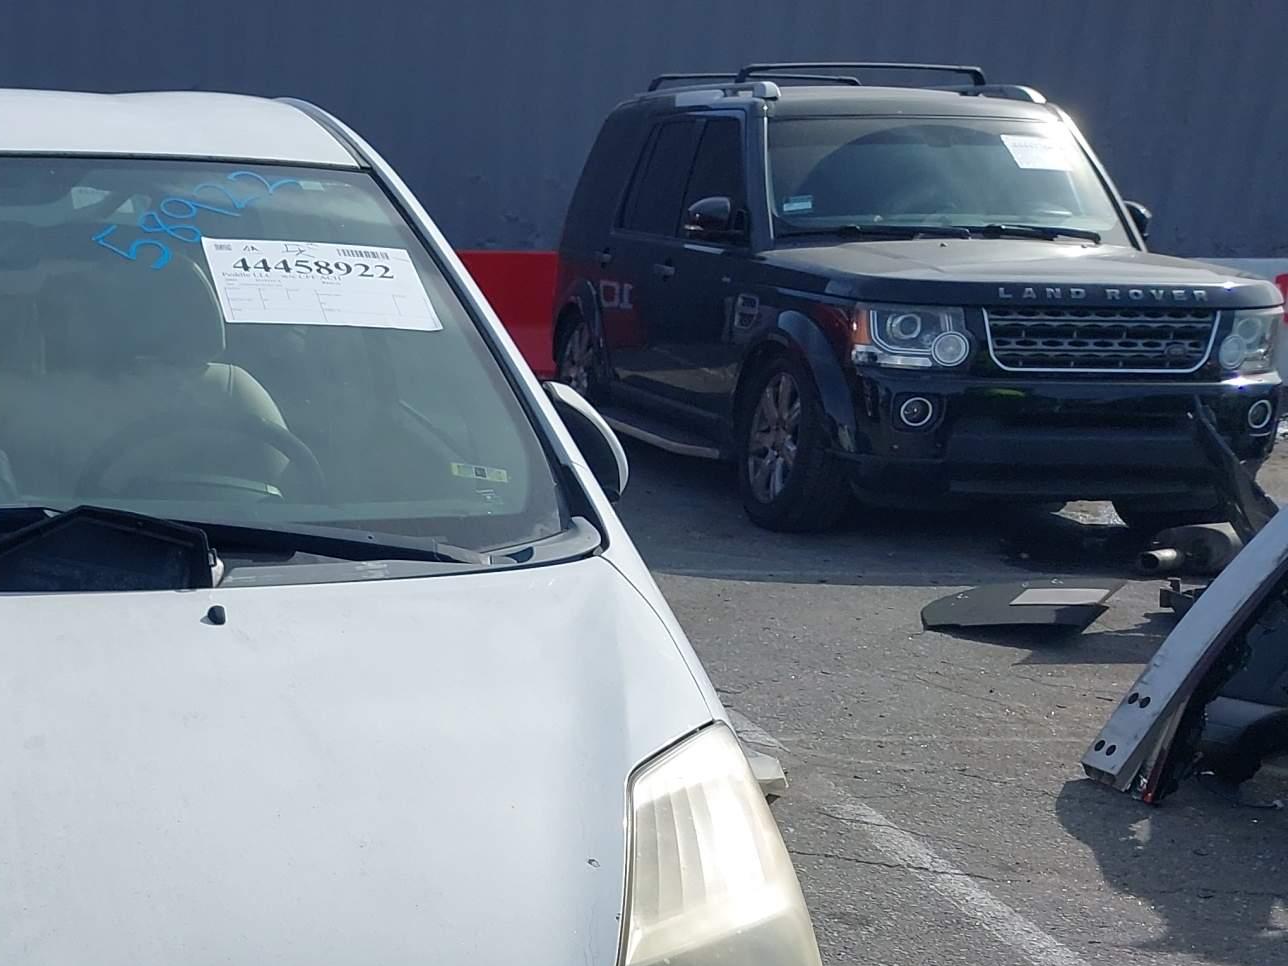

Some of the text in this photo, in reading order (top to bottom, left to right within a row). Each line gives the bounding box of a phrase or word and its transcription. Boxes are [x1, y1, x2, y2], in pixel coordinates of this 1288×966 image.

[91, 171, 304, 270] 58922
[232, 256, 395, 280] 44458922
[998, 287, 1209, 301] LAND ROVER
